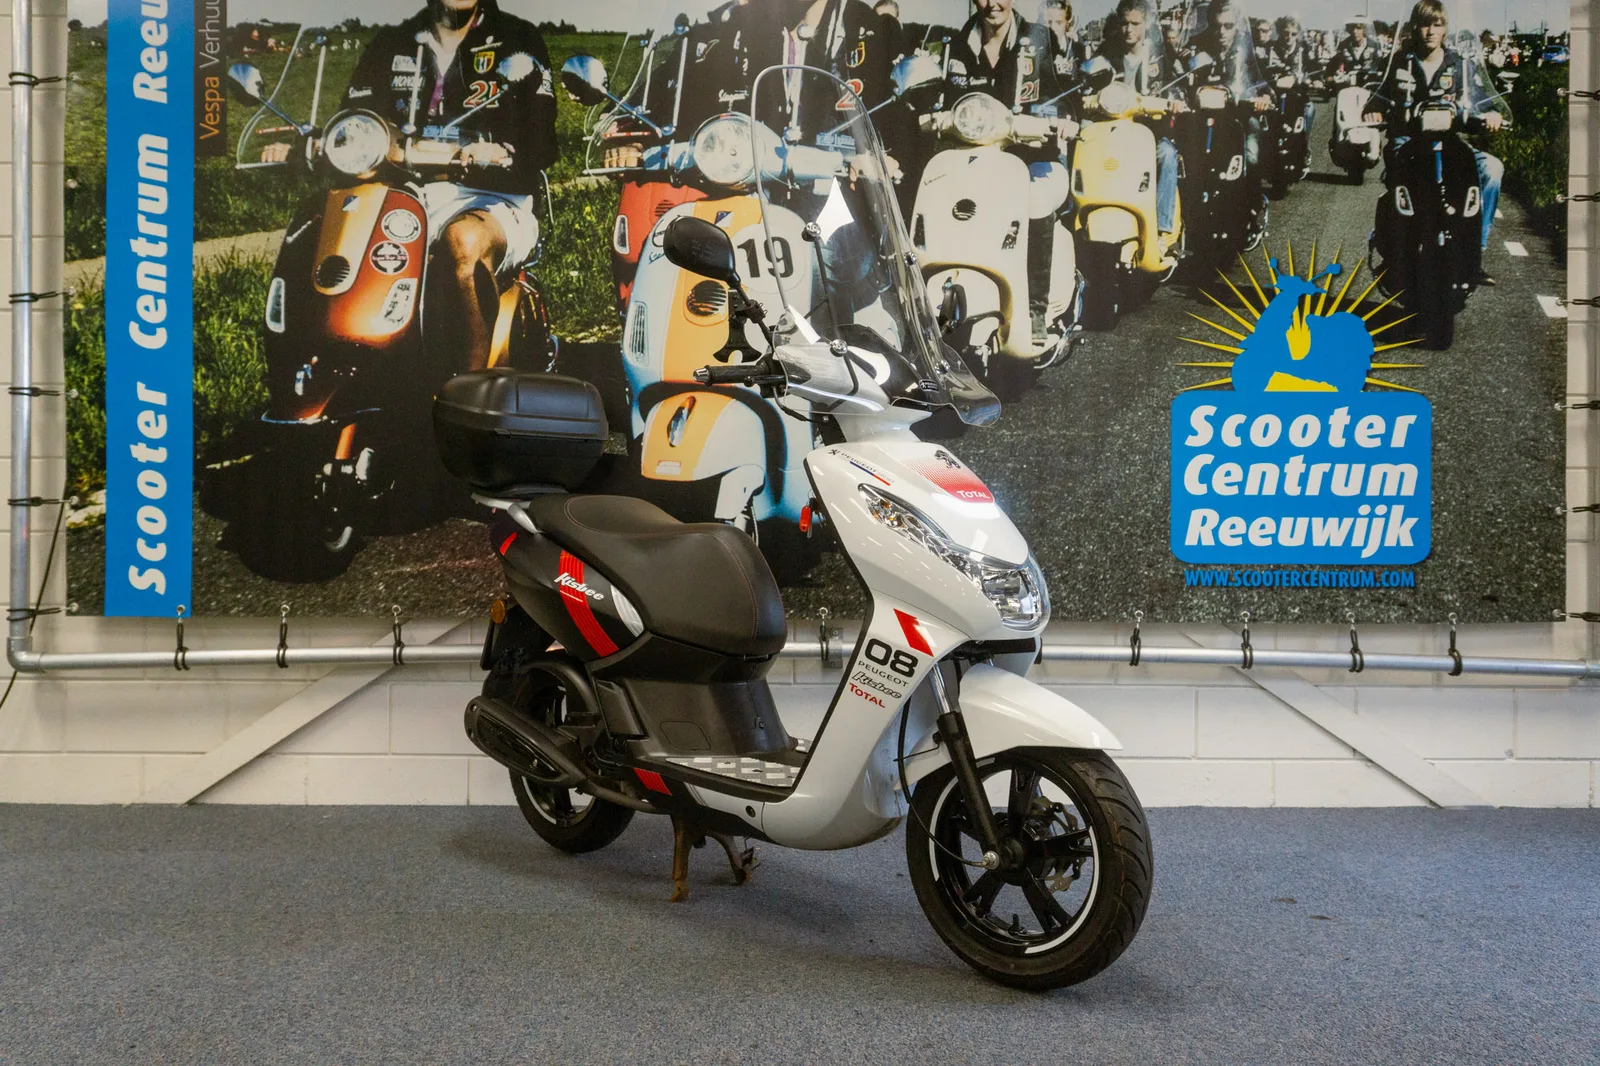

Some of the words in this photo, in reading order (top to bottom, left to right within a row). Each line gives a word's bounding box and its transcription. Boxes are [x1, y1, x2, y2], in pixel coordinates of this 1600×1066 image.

[199, 76, 225, 140] Vespa
[463, 80, 499, 108] 21
[1019, 79, 1040, 104] 21
[129, 133, 168, 350] Centrum
[737, 236, 794, 278] 19
[1184, 405, 1418, 448] Scooter
[128, 381, 168, 596] Scooter
[1184, 453, 1419, 496] Centrum
[956, 490, 990, 499] TOTAL
[1184, 504, 1419, 559] Reeuwijk
[553, 572, 604, 600] Kisbee
[1184, 570, 1416, 588] WWW.SCOOTERCENTRUM.COM
[858, 660, 909, 687] PEUGEOT
[864, 638, 919, 678] 08
[849, 682, 886, 709] TOTAL
[852, 671, 902, 699] Kisbee
